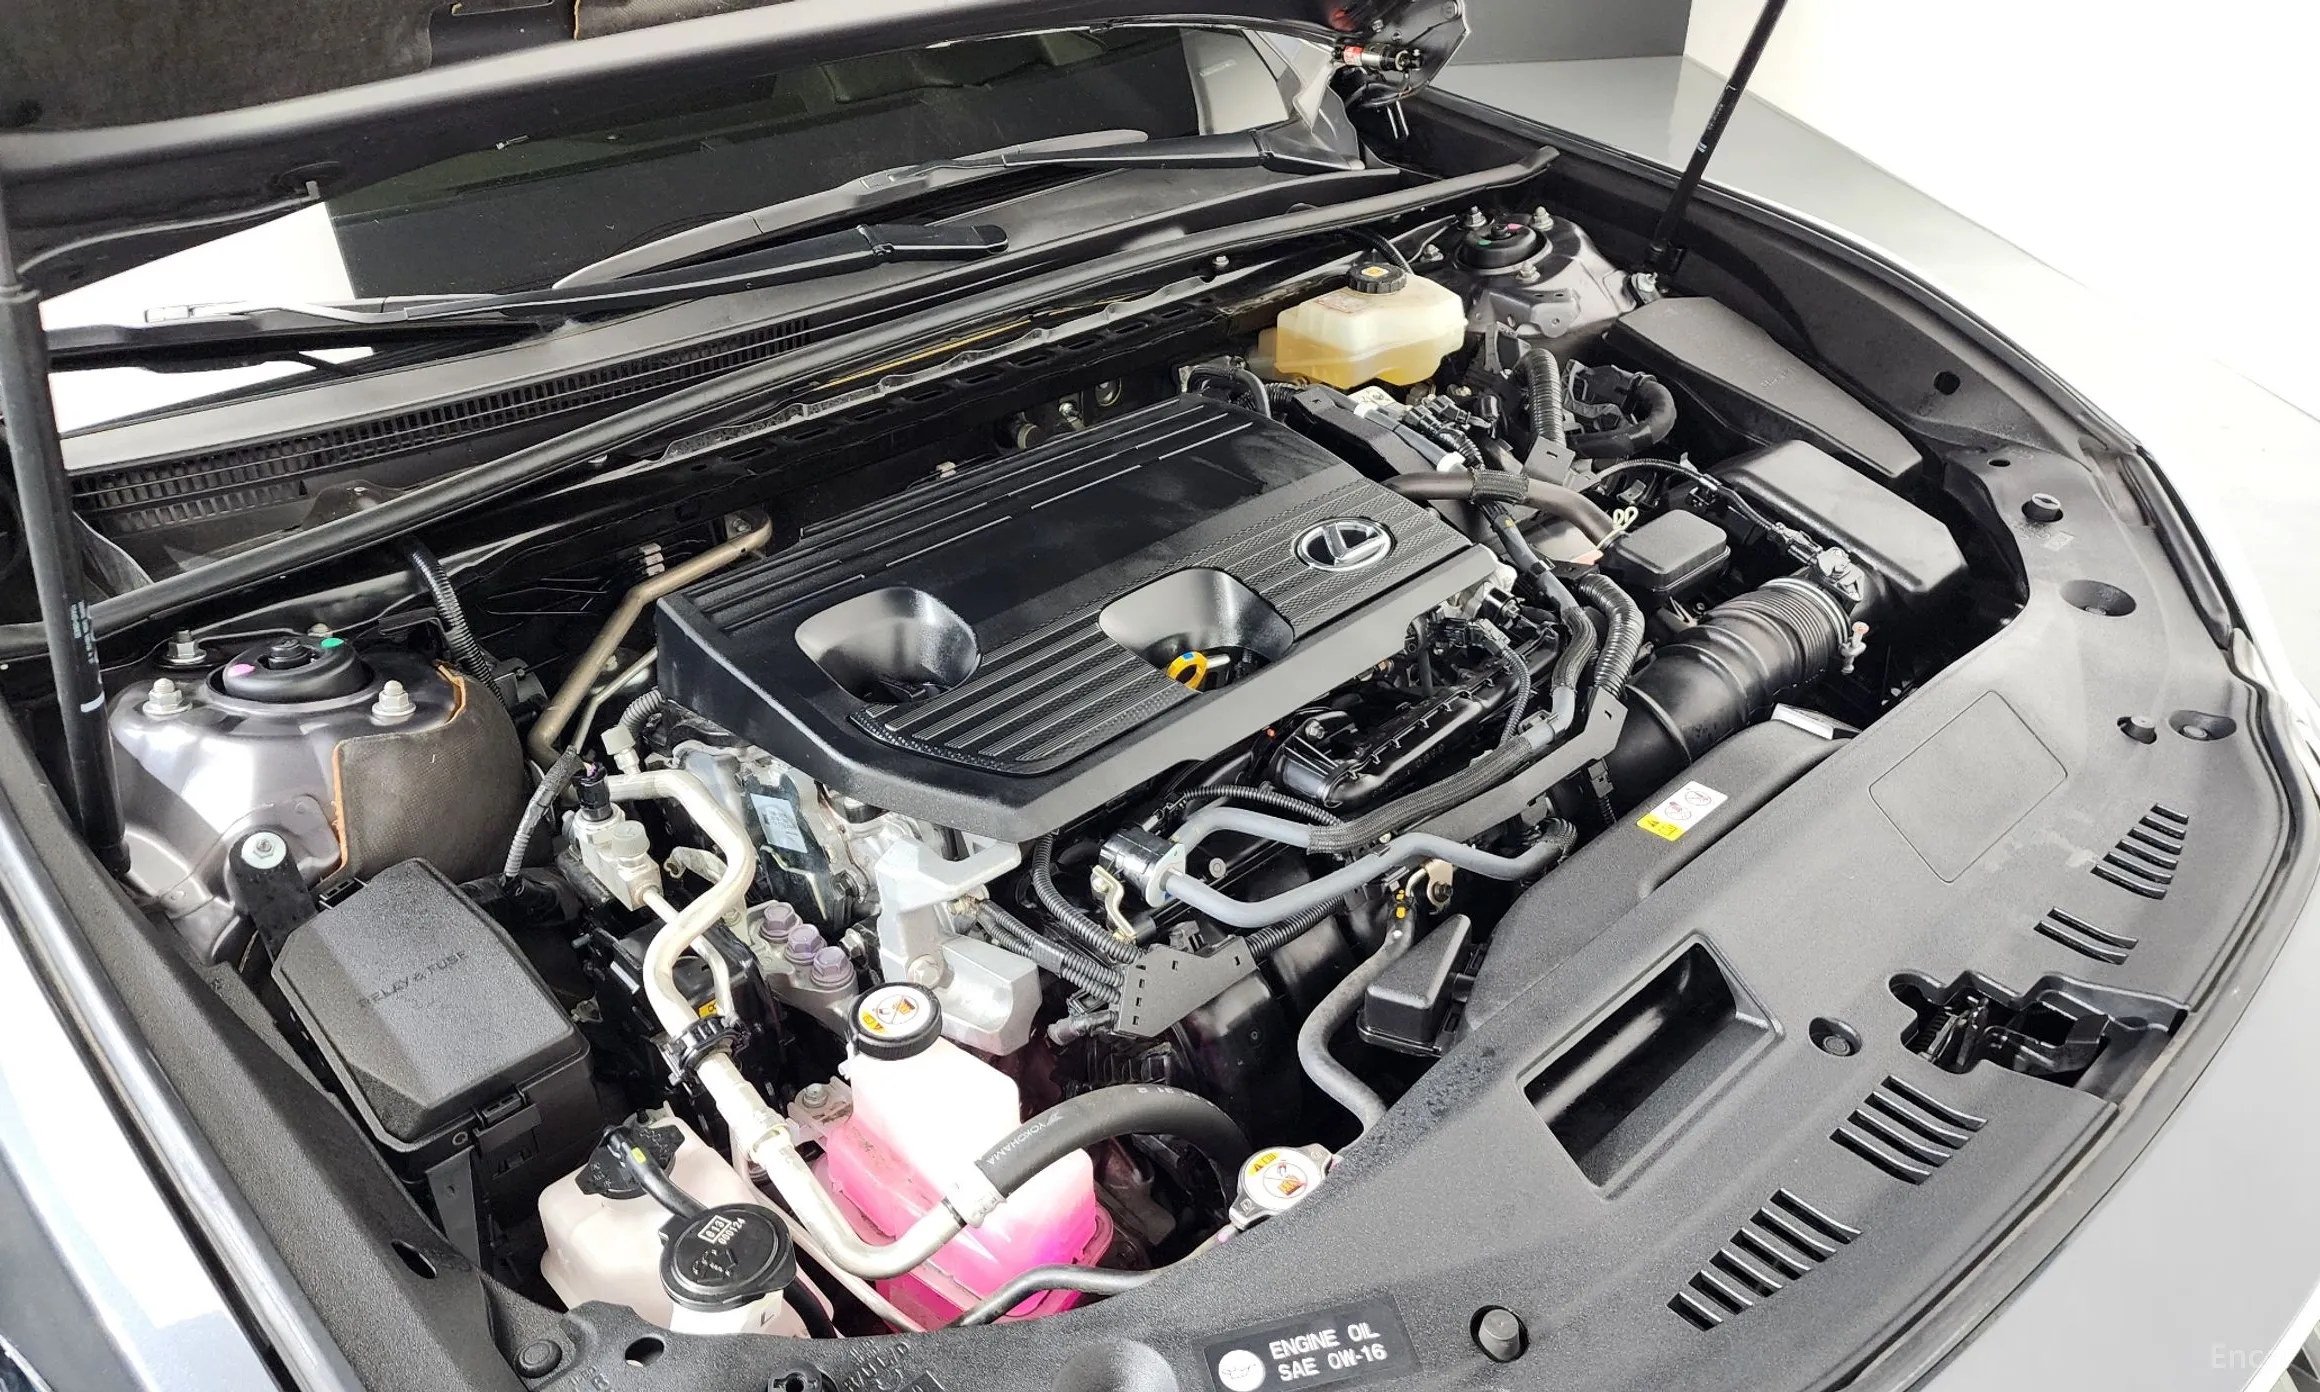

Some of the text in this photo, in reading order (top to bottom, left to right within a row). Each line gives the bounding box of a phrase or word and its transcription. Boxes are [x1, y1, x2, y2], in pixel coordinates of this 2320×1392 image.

[356, 976, 409, 1008] RELAY
[427, 951, 468, 975] FUSE
[986, 1122, 1047, 1165] YOKOHAMA
[717, 1216, 746, 1245] 000124
[1268, 1321, 1381, 1360] ENGINE OIL
[1277, 1342, 1389, 1381] SAE 0W-16
